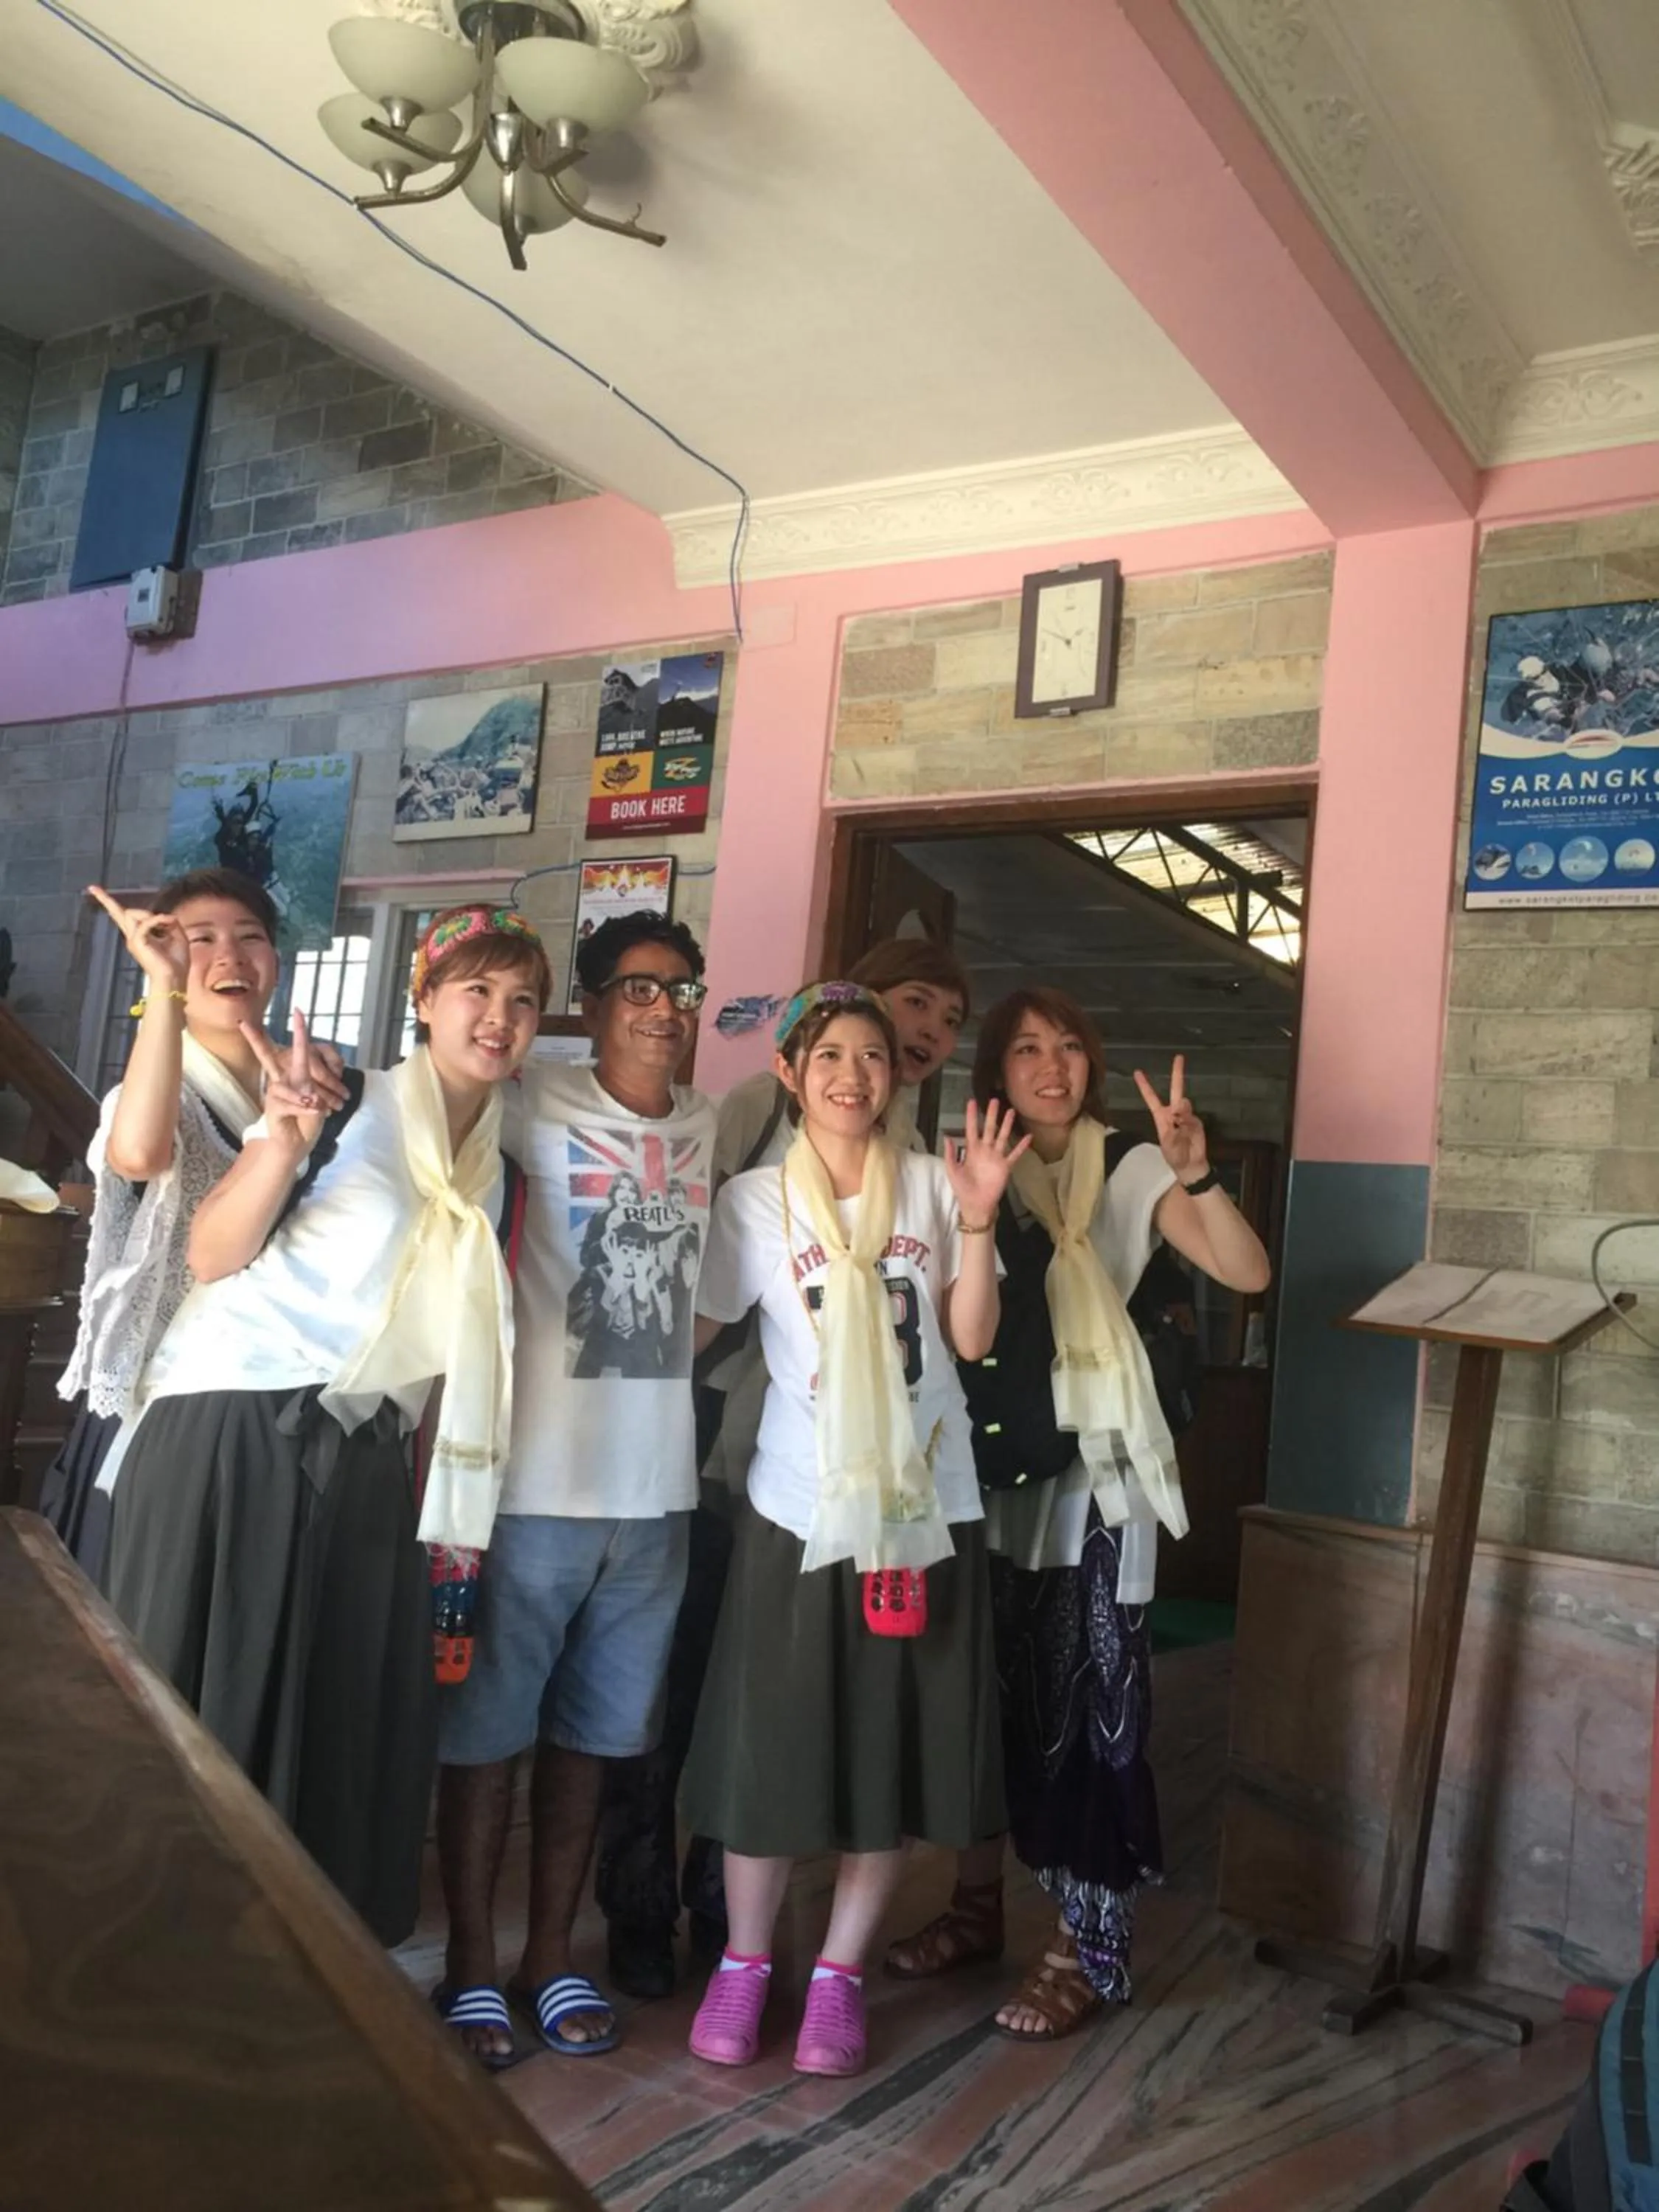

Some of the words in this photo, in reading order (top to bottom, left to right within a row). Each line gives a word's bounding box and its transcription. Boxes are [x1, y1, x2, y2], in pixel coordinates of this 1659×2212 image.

[611, 799, 647, 820] BOOK
[651, 795, 686, 816] HERE
[1502, 793, 1607, 809] PARAGLIDING
[1614, 793, 1638, 805] (P)
